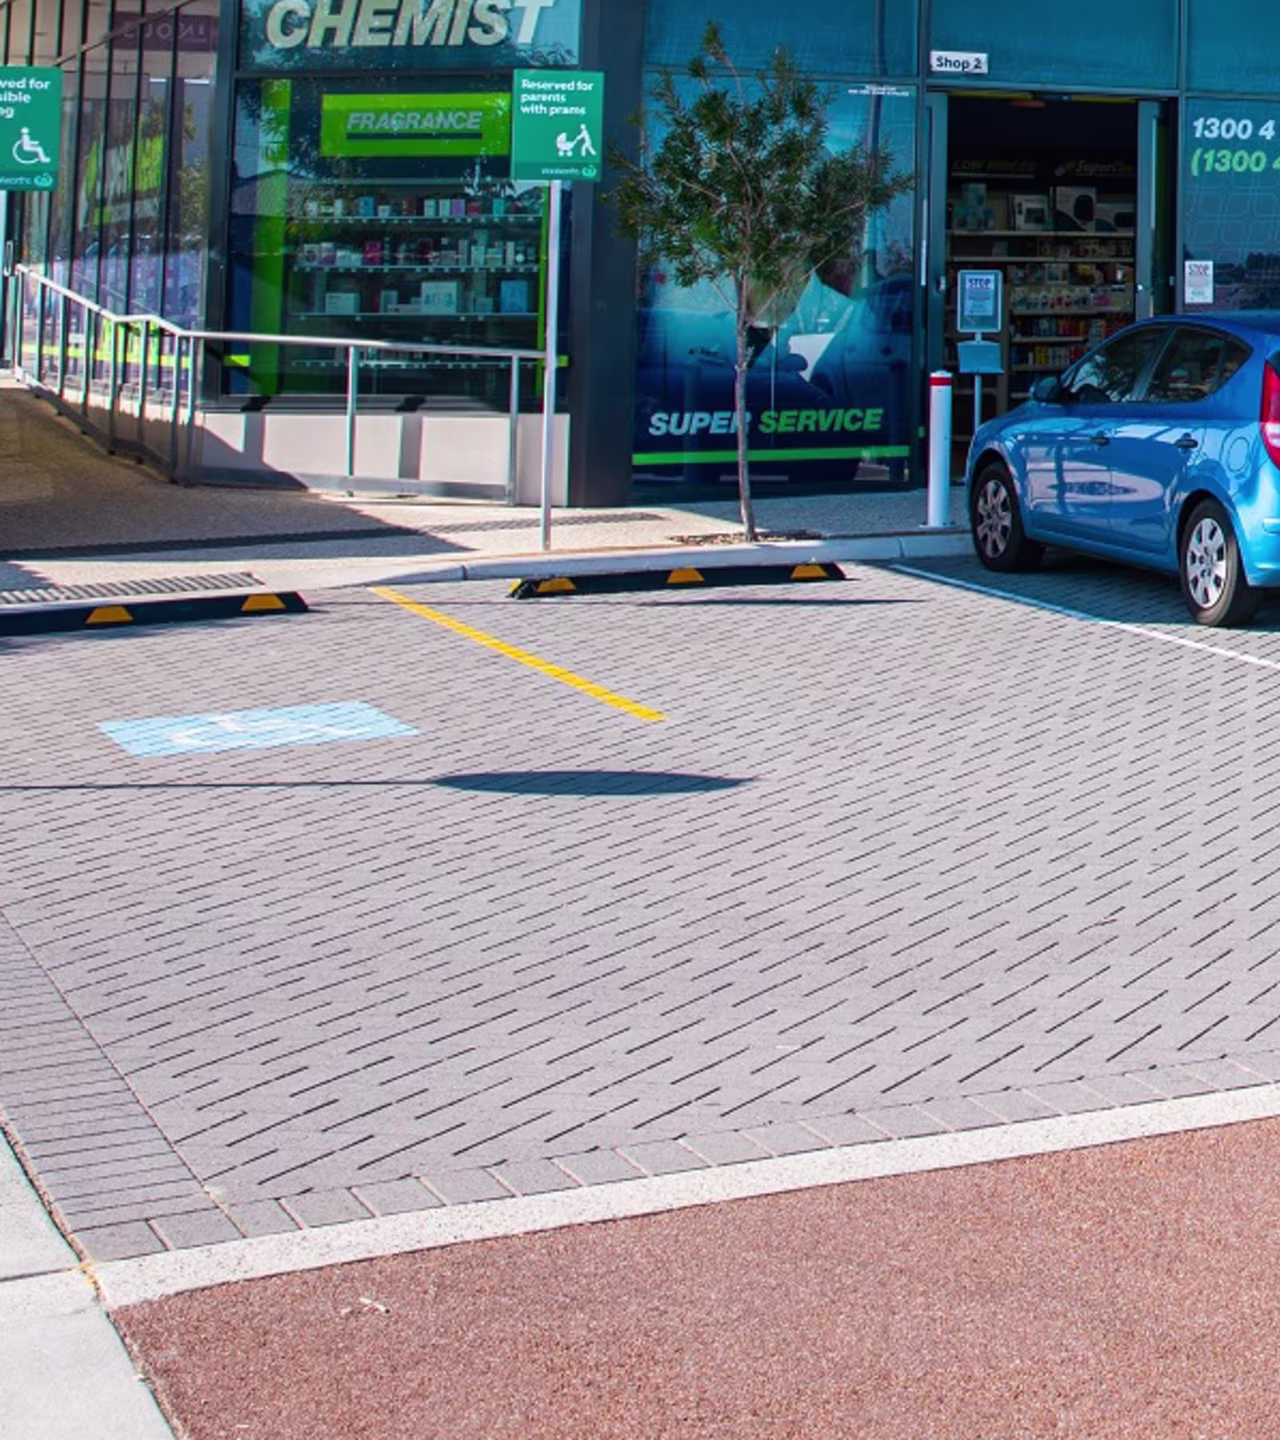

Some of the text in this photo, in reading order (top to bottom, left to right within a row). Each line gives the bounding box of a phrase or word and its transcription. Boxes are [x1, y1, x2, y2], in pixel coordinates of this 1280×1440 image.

[936, 55, 983, 71] Shop 2
[28, 77, 51, 90] for
[521, 79, 594, 91] Reserved for
[520, 93, 566, 103] parents
[520, 103, 587, 117] with prams
[347, 111, 483, 130] FRAGRANCE
[1193, 117, 1252, 140] 1300
[1258, 119, 1275, 140] 4
[1190, 148, 1267, 176] (1300
[758, 408, 884, 434] SERVICE
